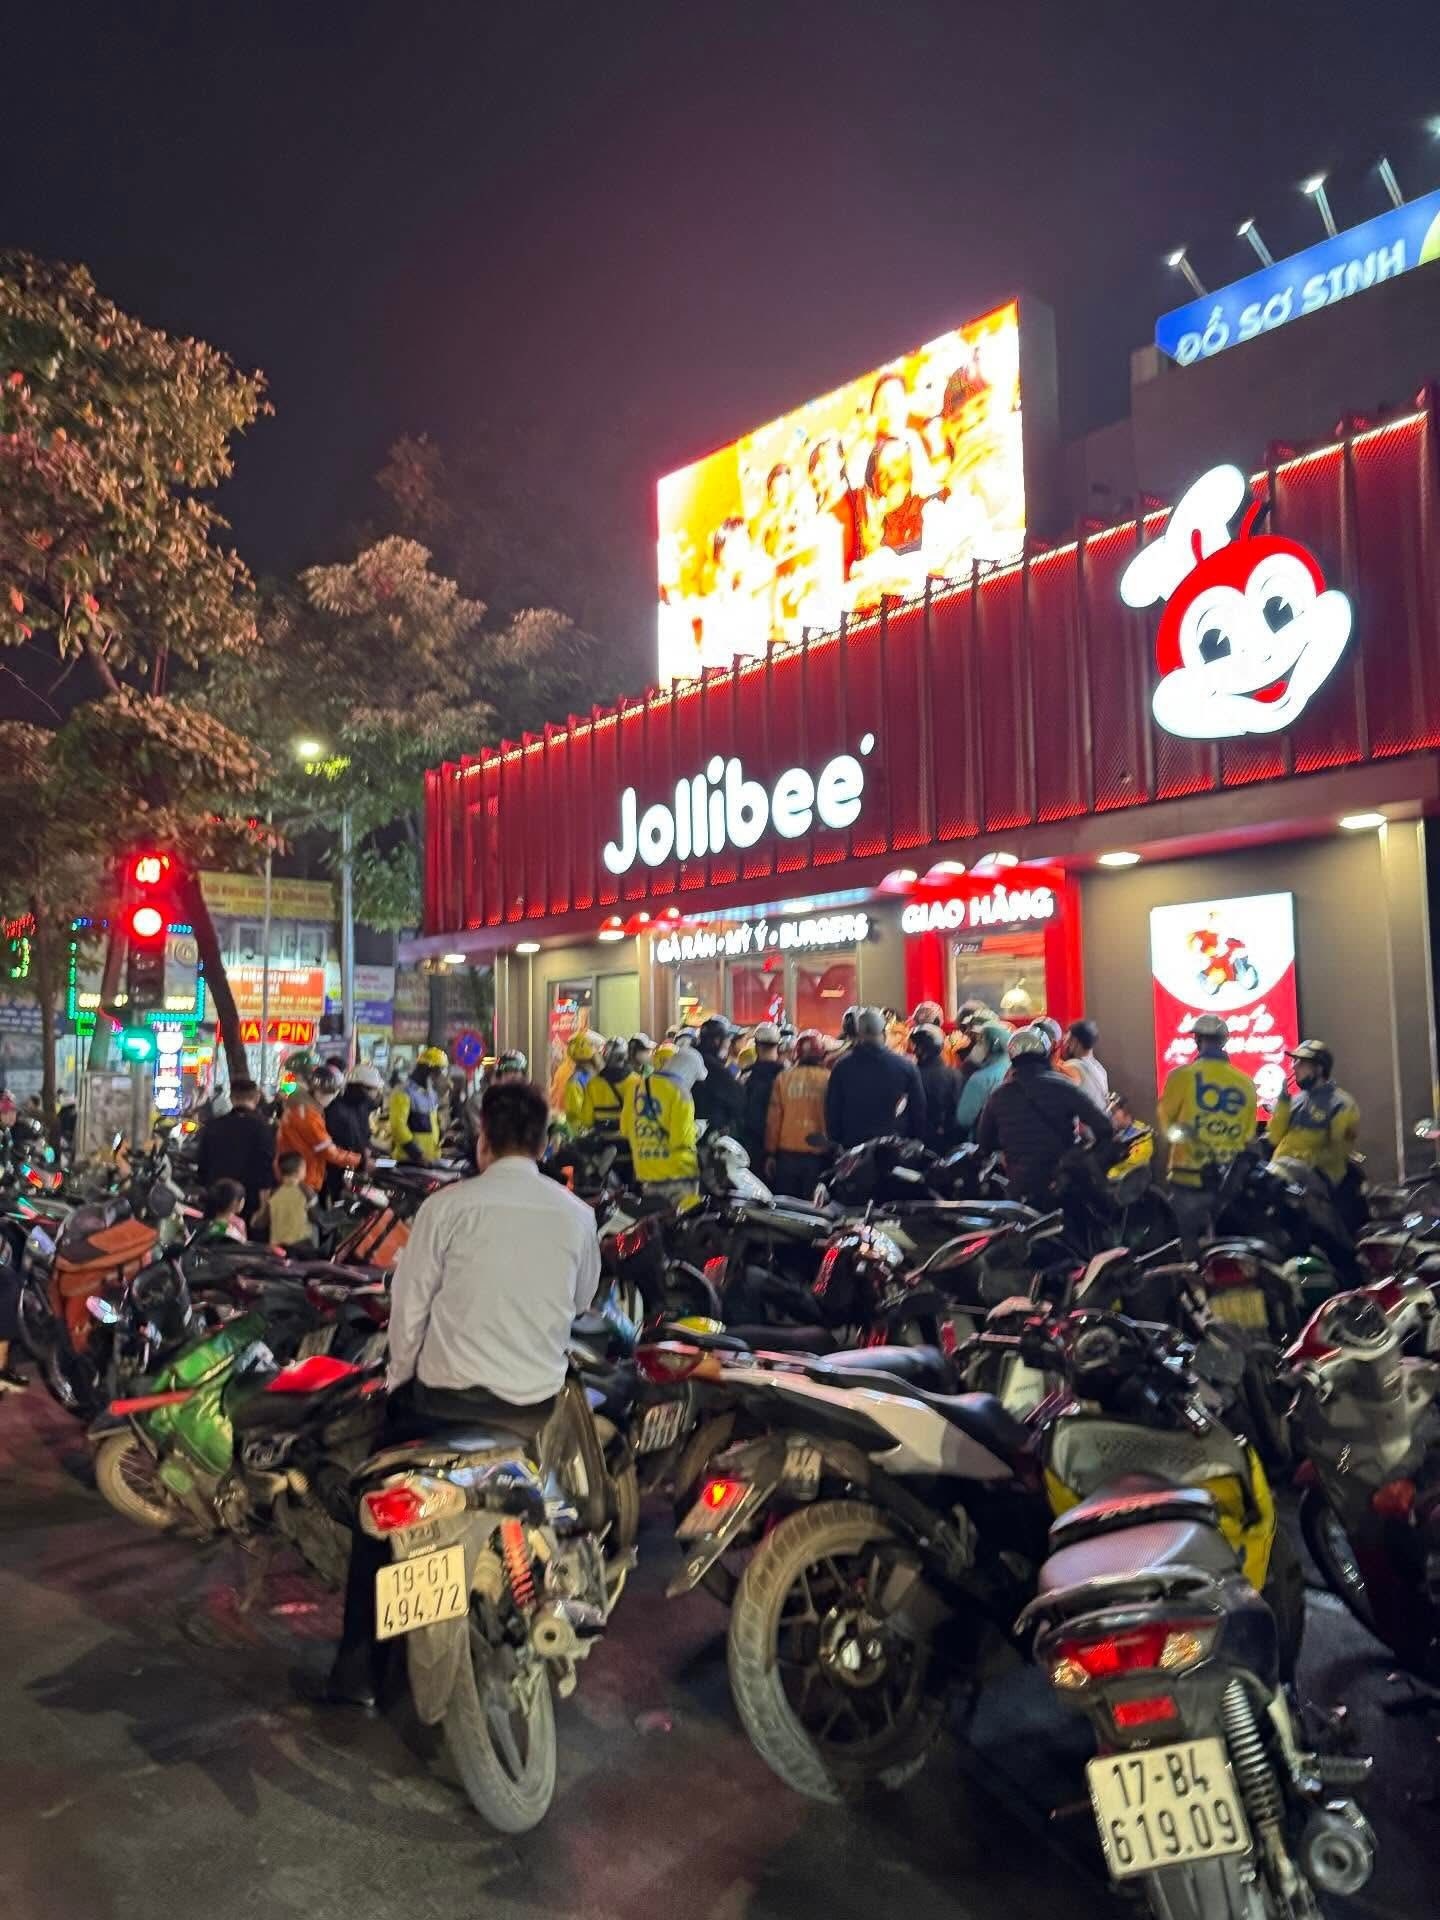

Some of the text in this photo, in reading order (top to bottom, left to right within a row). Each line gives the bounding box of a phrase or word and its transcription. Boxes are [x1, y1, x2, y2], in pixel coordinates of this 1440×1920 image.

[1238, 287, 1293, 340] SƠ
[1302, 239, 1406, 313] SINH
[603, 754, 865, 875] Jollibee
[779, 913, 869, 949] BURGERS
[902, 899, 966, 933] GIAO
[277, 1023, 311, 1042] PIN
[1195, 1071, 1246, 1115] be
[392, 1553, 449, 1596] 19-G1
[383, 1583, 461, 1631] 494.72
[1111, 1748, 1210, 1808] 17-B4
[1110, 1799, 1238, 1865] 619.09
